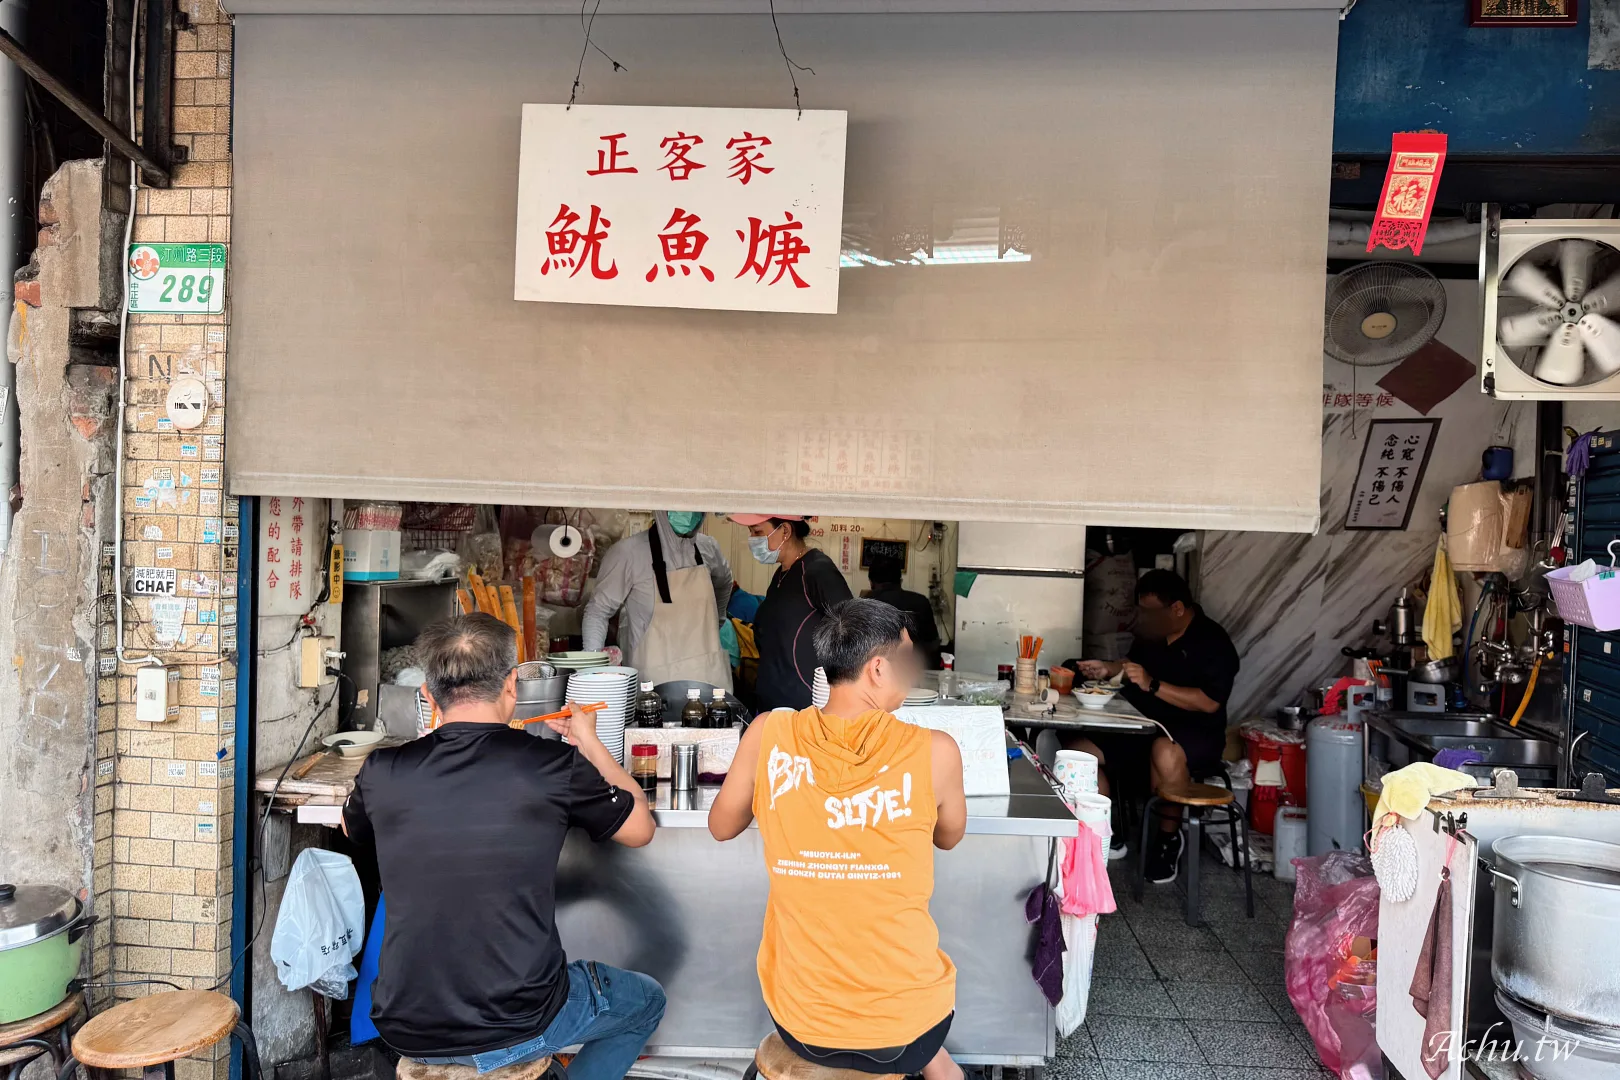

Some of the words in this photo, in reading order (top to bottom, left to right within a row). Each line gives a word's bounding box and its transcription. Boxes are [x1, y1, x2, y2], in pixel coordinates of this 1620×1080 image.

[586, 131, 775, 185] 正客家
[1393, 184, 1418, 211] 福
[160, 247, 222, 263] 汀州路三段
[540, 203, 811, 289] 魷魚焿
[159, 274, 215, 303] 289
[830, 523, 848, 532] 加料
[267, 496, 281, 588] 您的配合
[289, 497, 304, 600] 外帶請排隊
[135, 579, 175, 593] CHAF
[136, 568, 175, 580] 減肥就用
